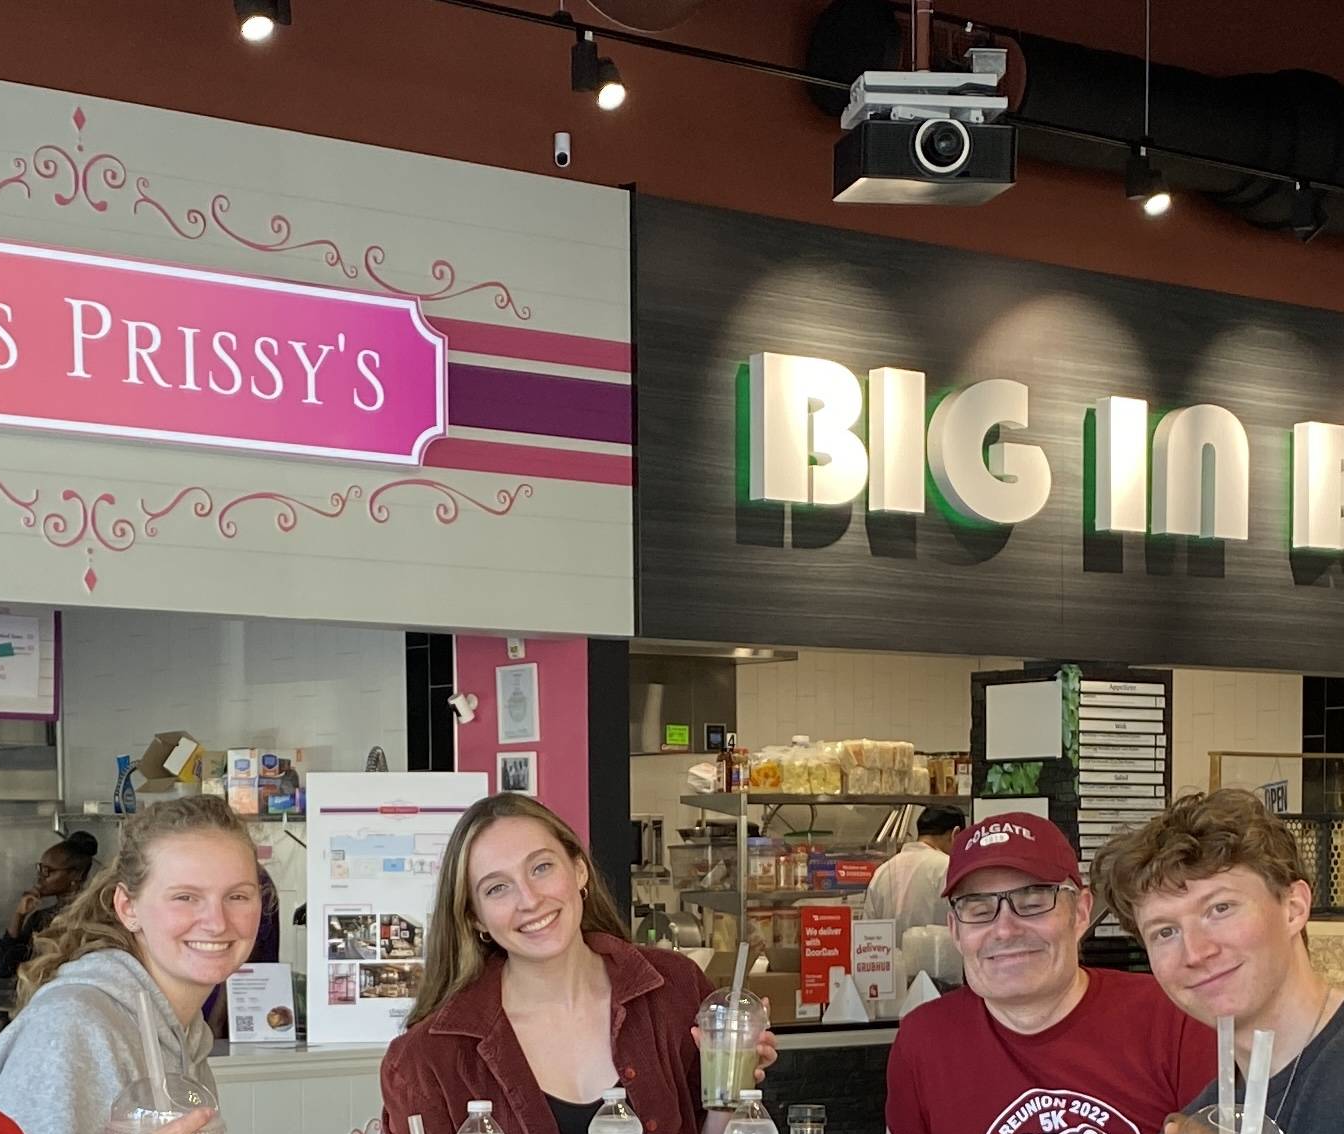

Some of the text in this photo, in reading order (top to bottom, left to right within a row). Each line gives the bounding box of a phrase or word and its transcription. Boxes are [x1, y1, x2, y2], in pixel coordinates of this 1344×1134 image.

[63, 296, 386, 413] PRISSY'S
[748, 351, 1052, 525] BIG
[1096, 396, 1251, 541] IN
[727, 734, 736, 748] 4
[1264, 783, 1288, 813] OPEN
[965, 822, 1036, 851] COLGATE
[805, 926, 842, 936] We deliver
[805, 938, 821, 947] with
[805, 947, 840, 957] DoorDash
[856, 943, 891, 956] delivery
[856, 961, 891, 973] GRUBHUB
[1038, 1109, 1068, 1133] 5K
[1068, 1099, 1111, 1127] 2022
